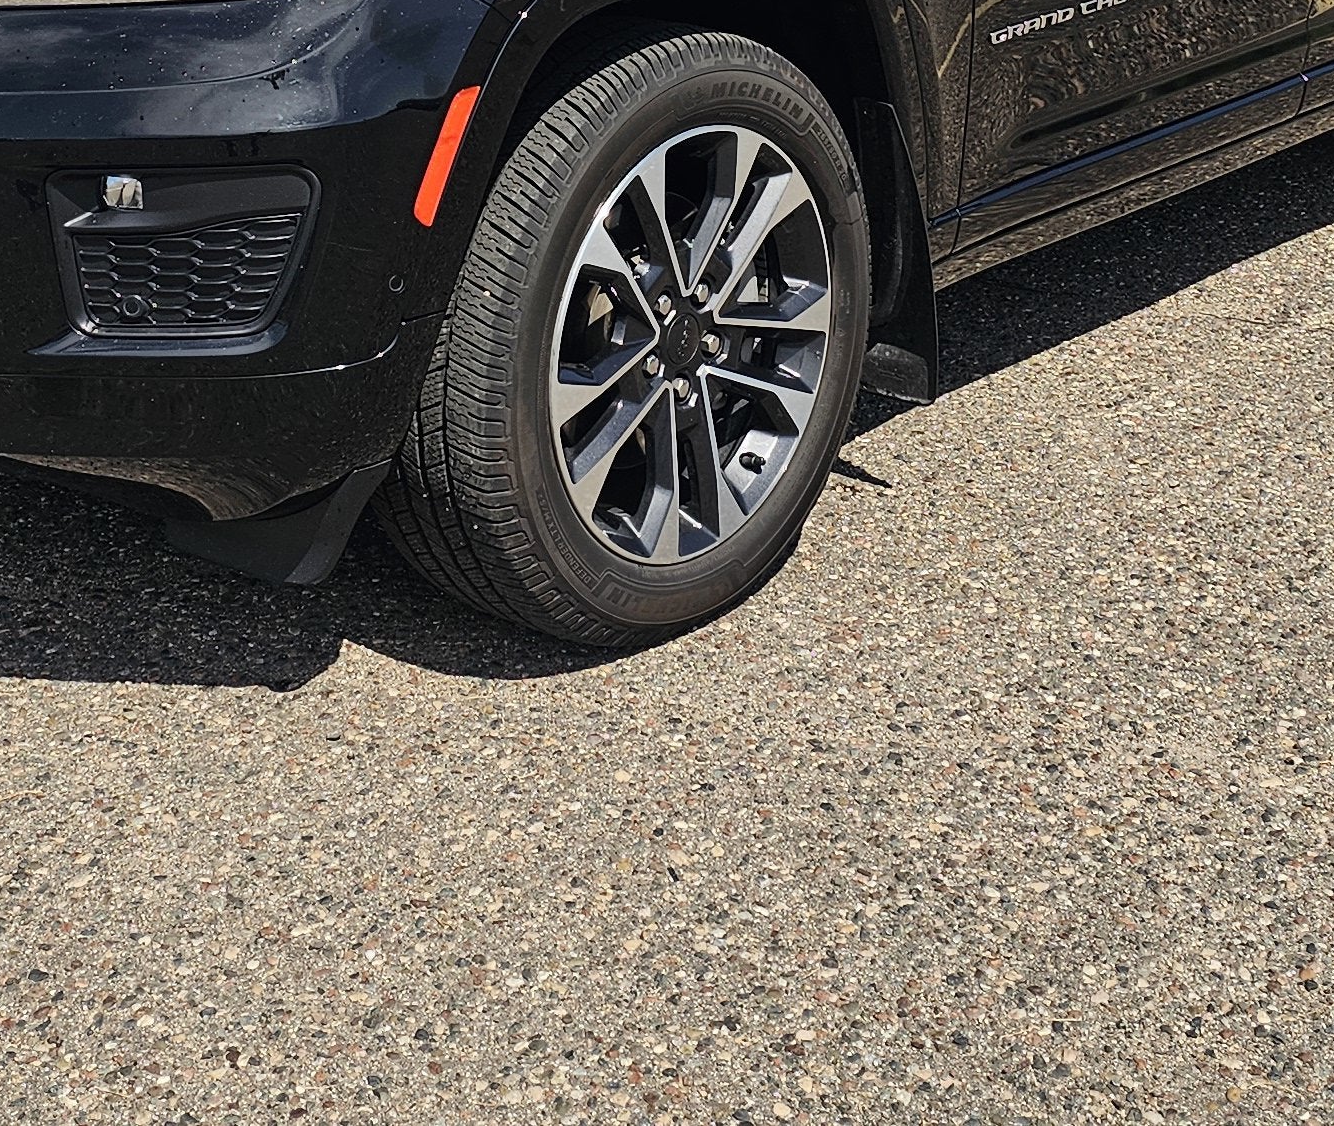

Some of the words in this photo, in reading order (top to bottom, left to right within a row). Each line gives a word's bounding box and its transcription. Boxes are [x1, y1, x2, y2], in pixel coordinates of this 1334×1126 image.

[989, 7, 1075, 45] GRAND
[711, 81, 805, 119] MICHELIN
[558, 540, 592, 583] DEFENDER
